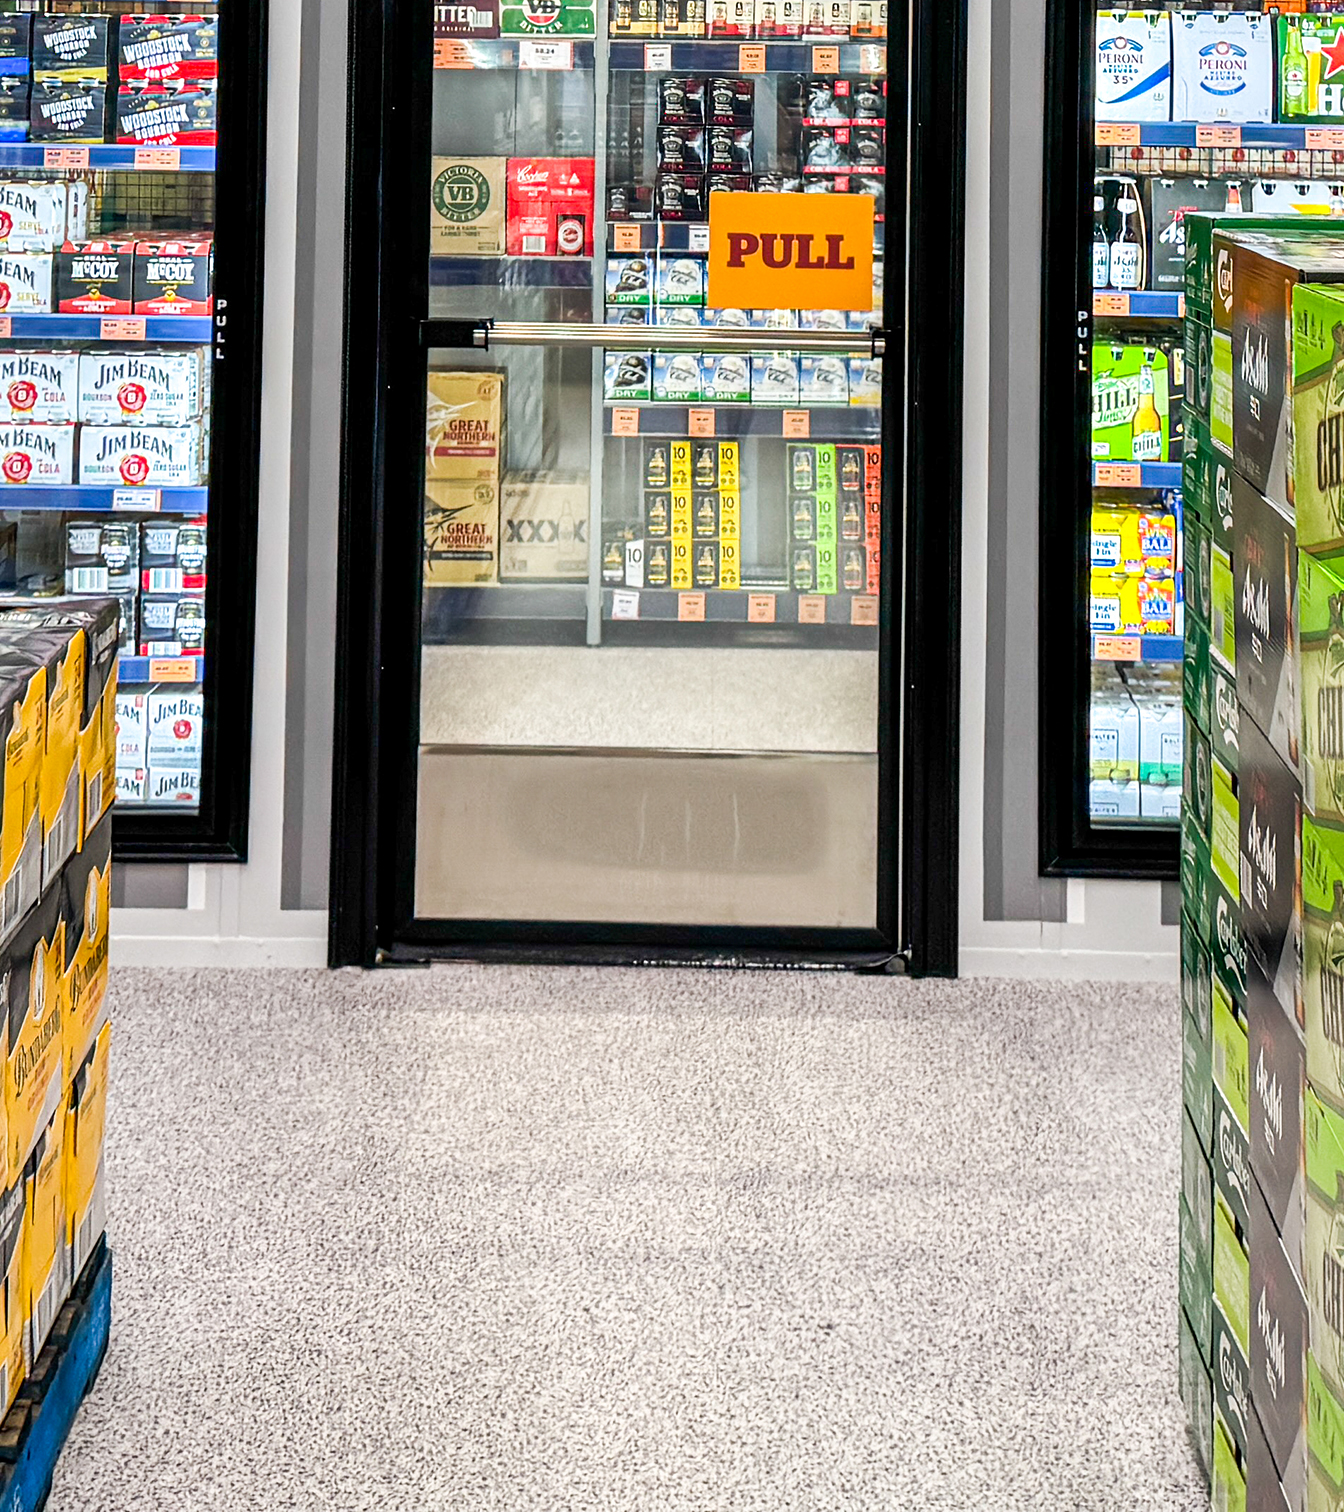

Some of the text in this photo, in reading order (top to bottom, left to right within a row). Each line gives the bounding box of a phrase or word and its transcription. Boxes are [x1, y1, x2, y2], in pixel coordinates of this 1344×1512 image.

[526, 0, 557, 14] VB
[519, 20, 564, 34] BITTER
[43, 25, 98, 49] WOODSTOCK
[122, 33, 192, 64] WOODSTOCK
[136, 51, 183, 70] BOURBON
[1099, 53, 1145, 64] PERONI
[1199, 58, 1248, 71] PERONI
[41, 95, 95, 119] WOODSTOCK
[120, 103, 190, 134] WOODSTOCK
[437, 166, 484, 184] VICTORIA
[447, 185, 476, 202] VB
[726, 233, 855, 270] PULL
[619, 294, 641, 303] DRY
[215, 298, 228, 360] PULL
[1076, 310, 1090, 371] PULL
[18, 357, 62, 388] BEAM
[95, 359, 171, 391] JIM BEAM
[449, 419, 490, 432] GREAT
[442, 432, 496, 442] NORTHERN
[674, 446, 687, 460] 10
[818, 452, 831, 464] 10
[446, 522, 488, 535] GREAT
[440, 534, 494, 545] NORTHERN
[1143, 538, 1172, 552] BALI
[626, 547, 643, 563] 10
